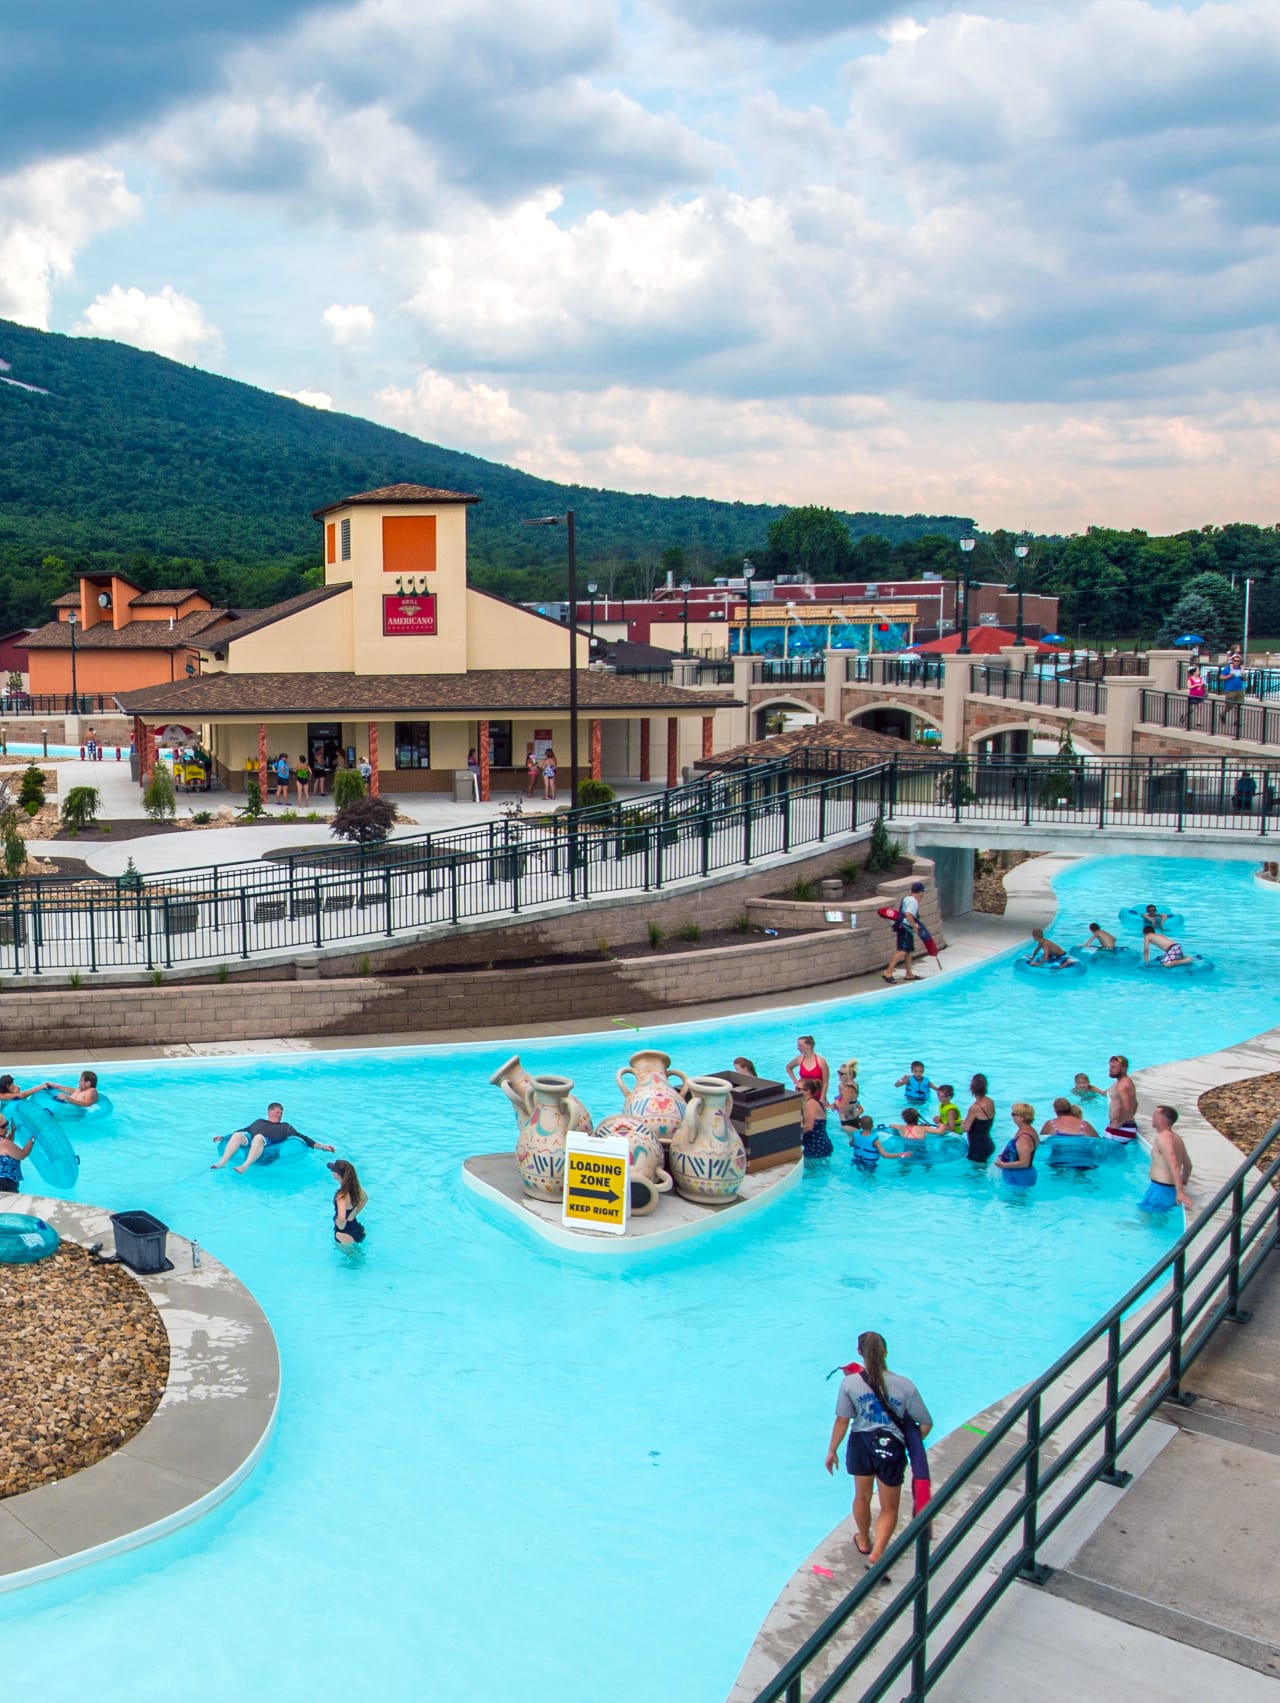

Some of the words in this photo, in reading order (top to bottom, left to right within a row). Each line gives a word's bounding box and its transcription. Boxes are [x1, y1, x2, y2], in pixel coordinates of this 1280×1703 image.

[388, 617, 433, 625] AMERICANO
[570, 1160, 622, 1176] LOADING
[580, 1174, 610, 1187] ZONE
[569, 1203, 591, 1213] KEEP
[593, 1206, 620, 1217] RIGHT
